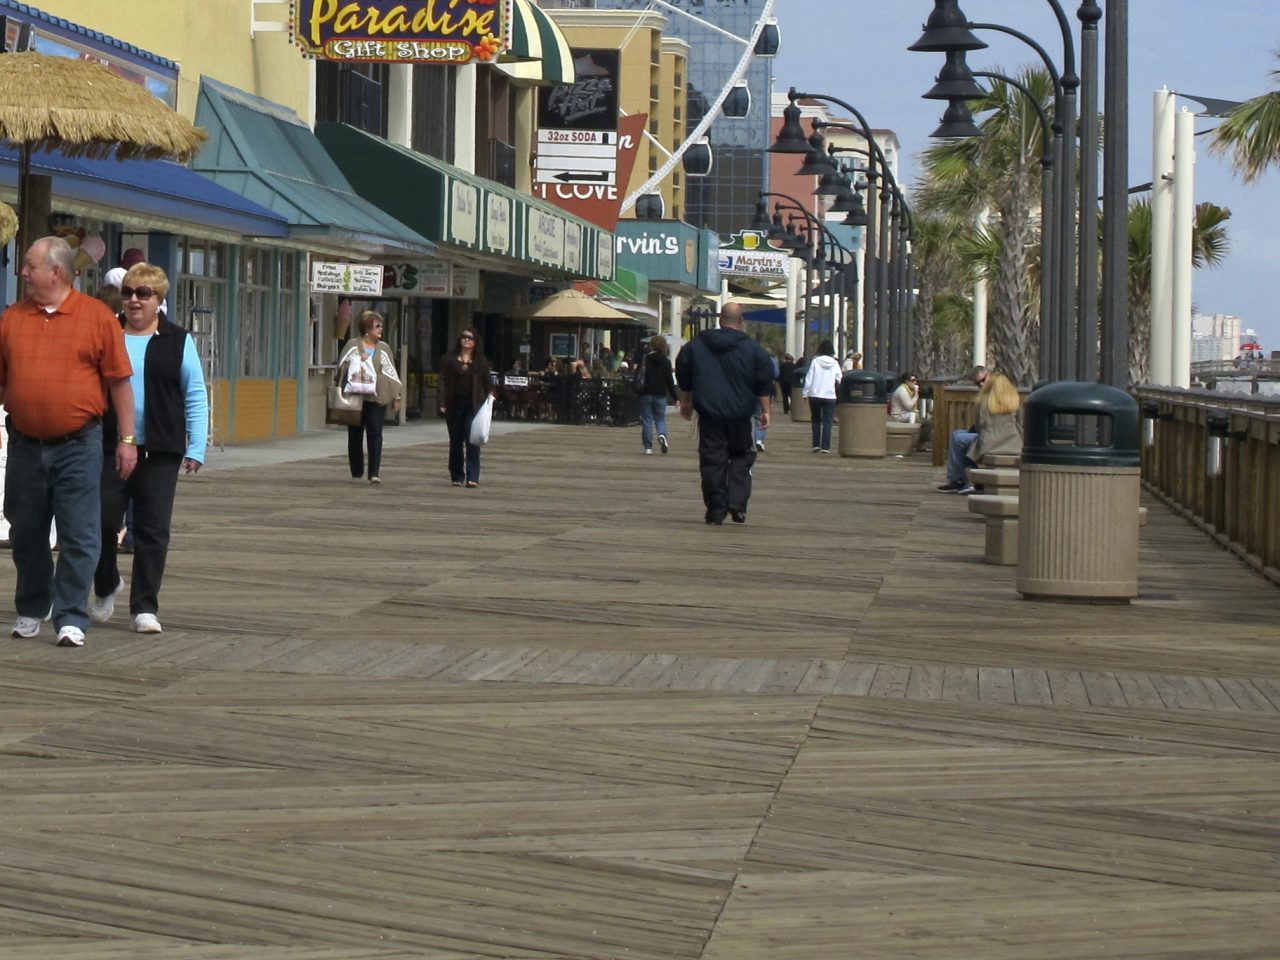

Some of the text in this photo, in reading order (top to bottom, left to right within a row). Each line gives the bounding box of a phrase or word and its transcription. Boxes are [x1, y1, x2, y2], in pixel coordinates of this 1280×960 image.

[333, 40, 466, 60] Gift Shop
[548, 131, 597, 142] 32oz SODA
[556, 185, 618, 200] COVE
[616, 232, 679, 255] rvin's
[736, 255, 783, 267] Marvin's
